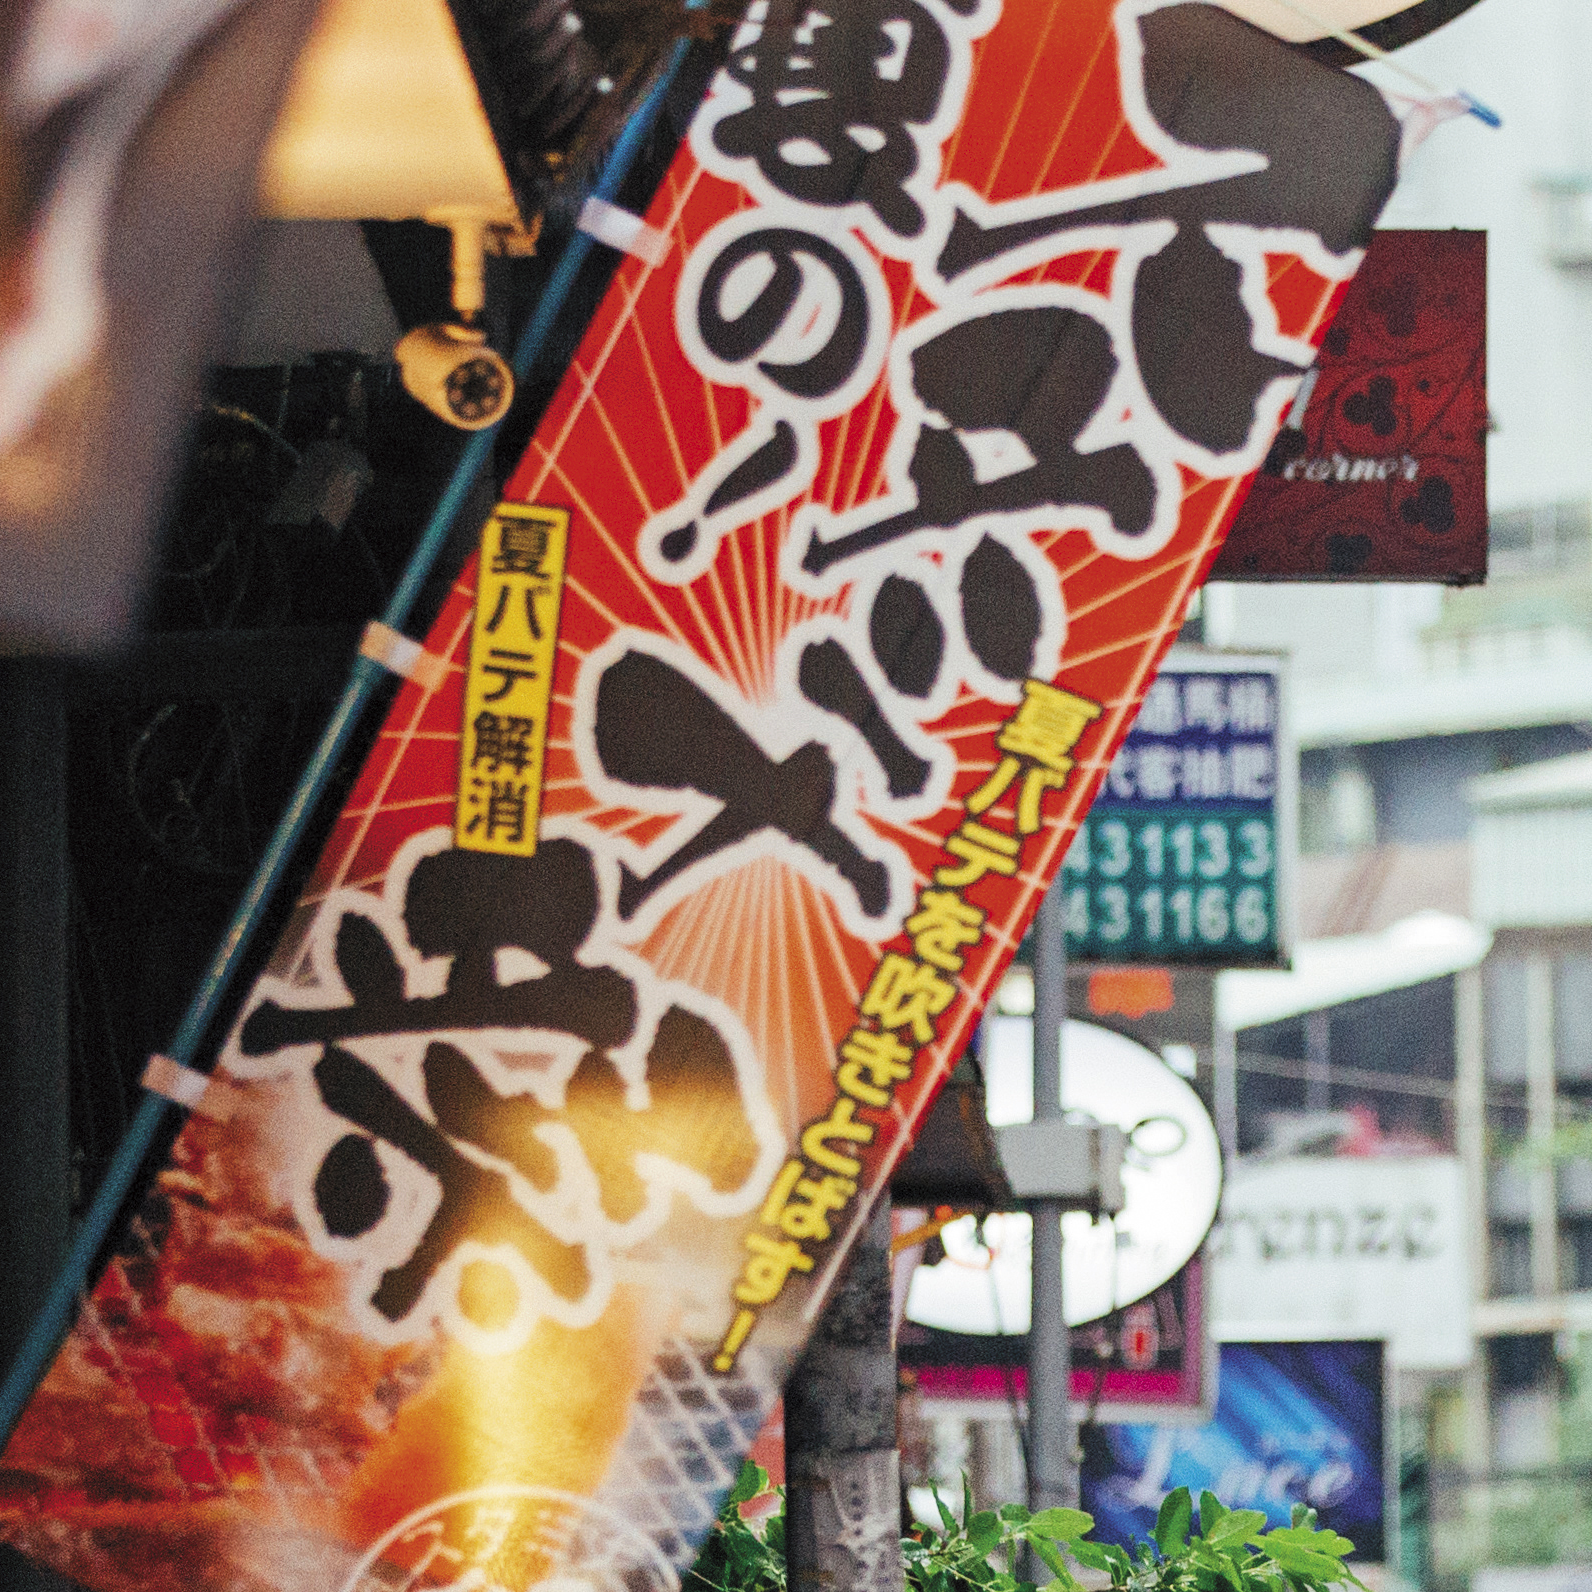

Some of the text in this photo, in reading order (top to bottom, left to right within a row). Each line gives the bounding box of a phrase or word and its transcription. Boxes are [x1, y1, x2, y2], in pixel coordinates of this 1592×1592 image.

[466, 514, 558, 844] 夏バテ解消
[714, 678, 1103, 1374] 夏バテを吹きとばす!
